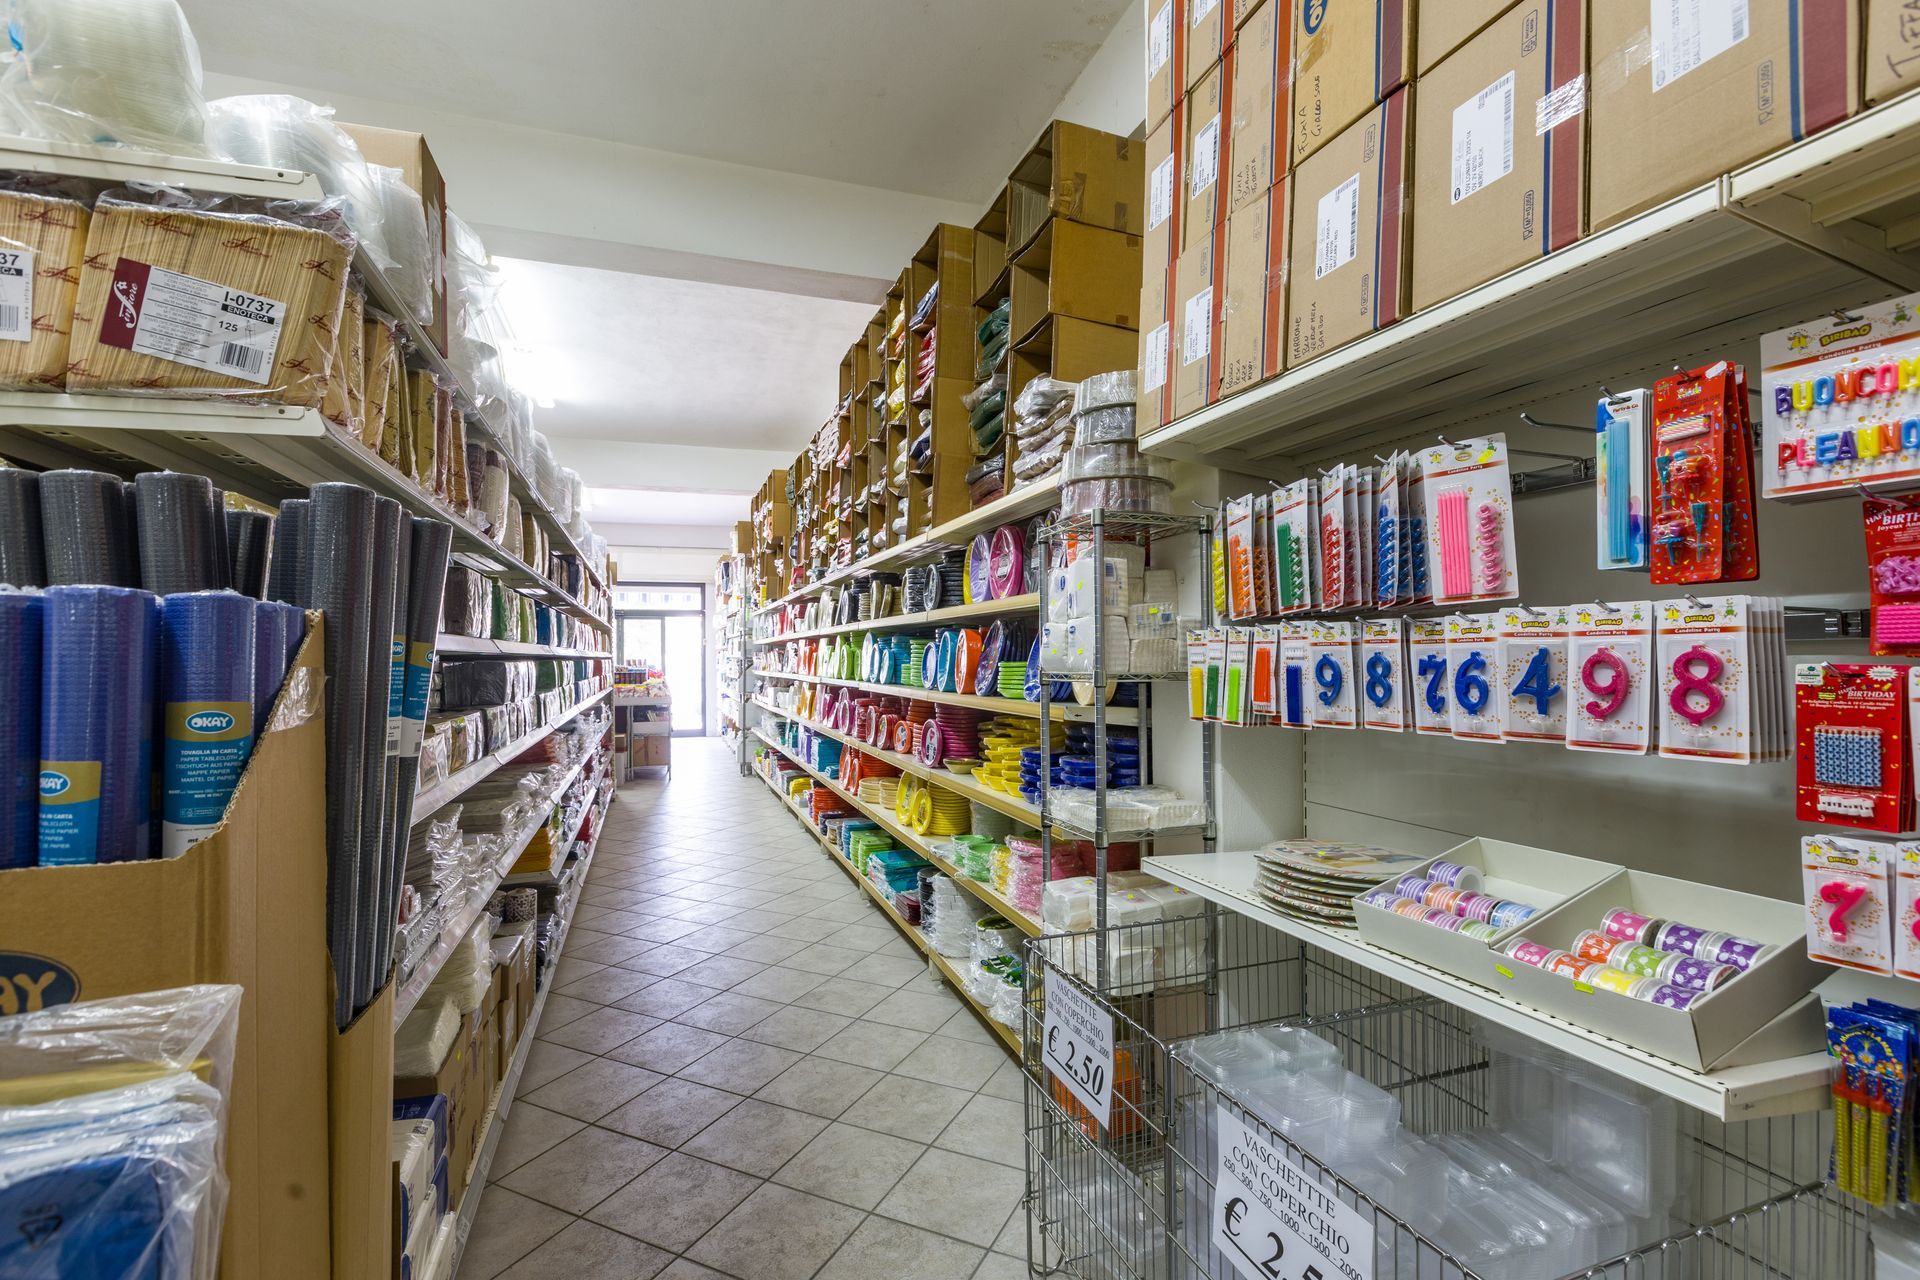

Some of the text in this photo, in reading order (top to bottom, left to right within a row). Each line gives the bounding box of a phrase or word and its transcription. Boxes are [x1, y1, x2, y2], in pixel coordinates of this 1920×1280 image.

[224, 291, 275, 314] I-0737
[227, 305, 270, 323] ENOTECA
[218, 321, 239, 332] 125
[1819, 324, 1872, 347] BIRIBAO
[1859, 342, 1882, 351] Party
[191, 717, 229, 728] OKAY
[181, 748, 210, 756] TOVAGLIA
[1051, 991, 1104, 1042] CON COPERCHIO
[1048, 1025, 1104, 1096] € 2.50
[1223, 1155, 1236, 1173] 250
[1241, 1175, 1253, 1191] 500
[1259, 1191, 1272, 1210] 750
[1280, 1210, 1299, 1233] 1000
[1309, 1234, 1330, 1258] 1500
[1232, 1146, 1349, 1255] CON COPERCHIO
[1224, 1197, 1248, 1237] €
